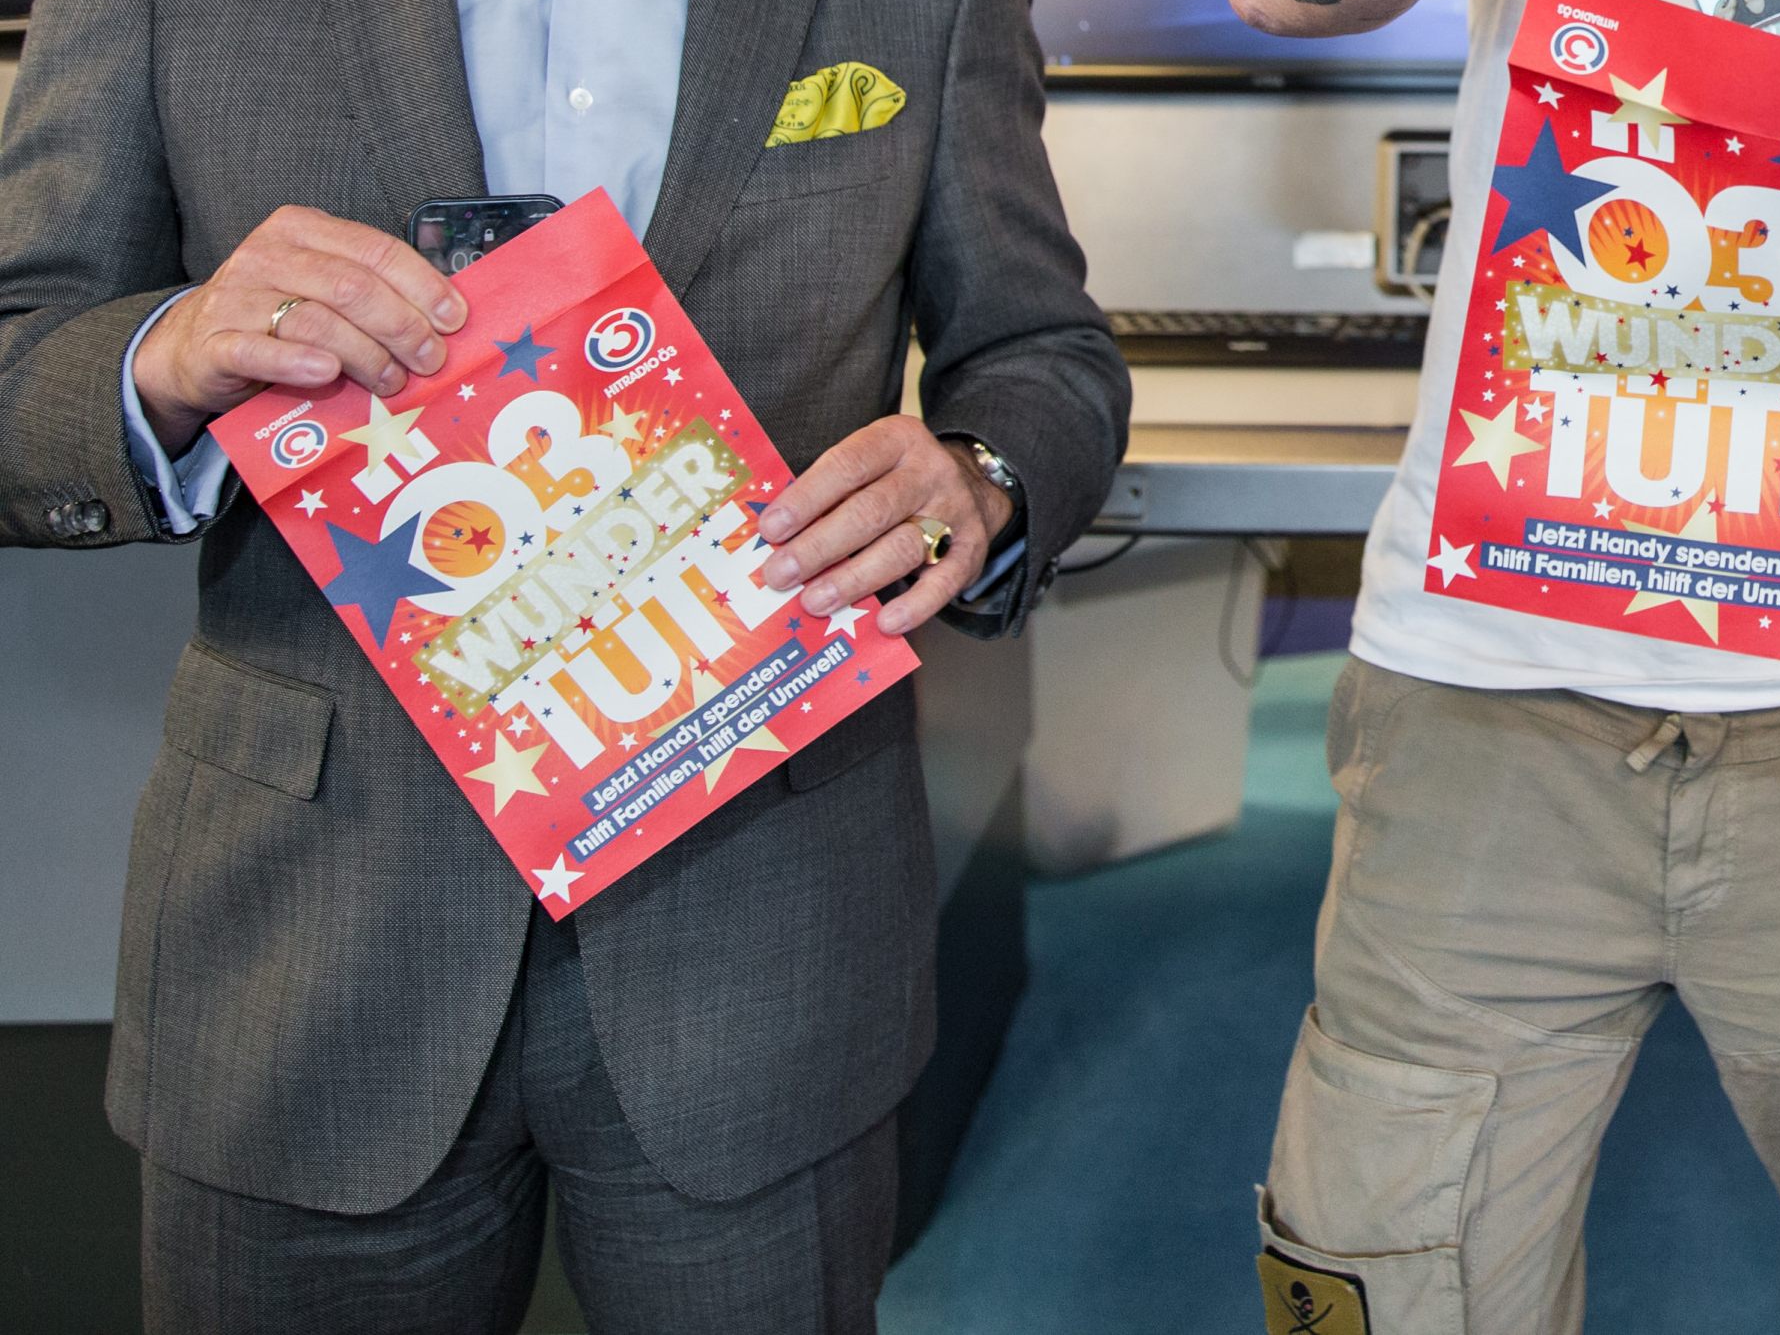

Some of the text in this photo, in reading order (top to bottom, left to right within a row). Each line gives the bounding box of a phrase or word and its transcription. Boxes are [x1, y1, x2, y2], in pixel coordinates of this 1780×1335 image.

[603, 345, 677, 399] HITRADIO Ö3
[429, 443, 734, 694] WUNDER
[1488, 547, 1532, 572] hilft
[1535, 554, 1643, 592] Familien,
[1647, 568, 1692, 594] hilft
[1695, 580, 1738, 601] der
[1528, 522, 1587, 549] Jetzt
[1590, 529, 1671, 563] Handy
[574, 641, 849, 857] hilft Familien, hilft der Umwelt!
[592, 765, 640, 811] Jetzt
[635, 719, 703, 775] Handy
[703, 658, 787, 725] spenden
